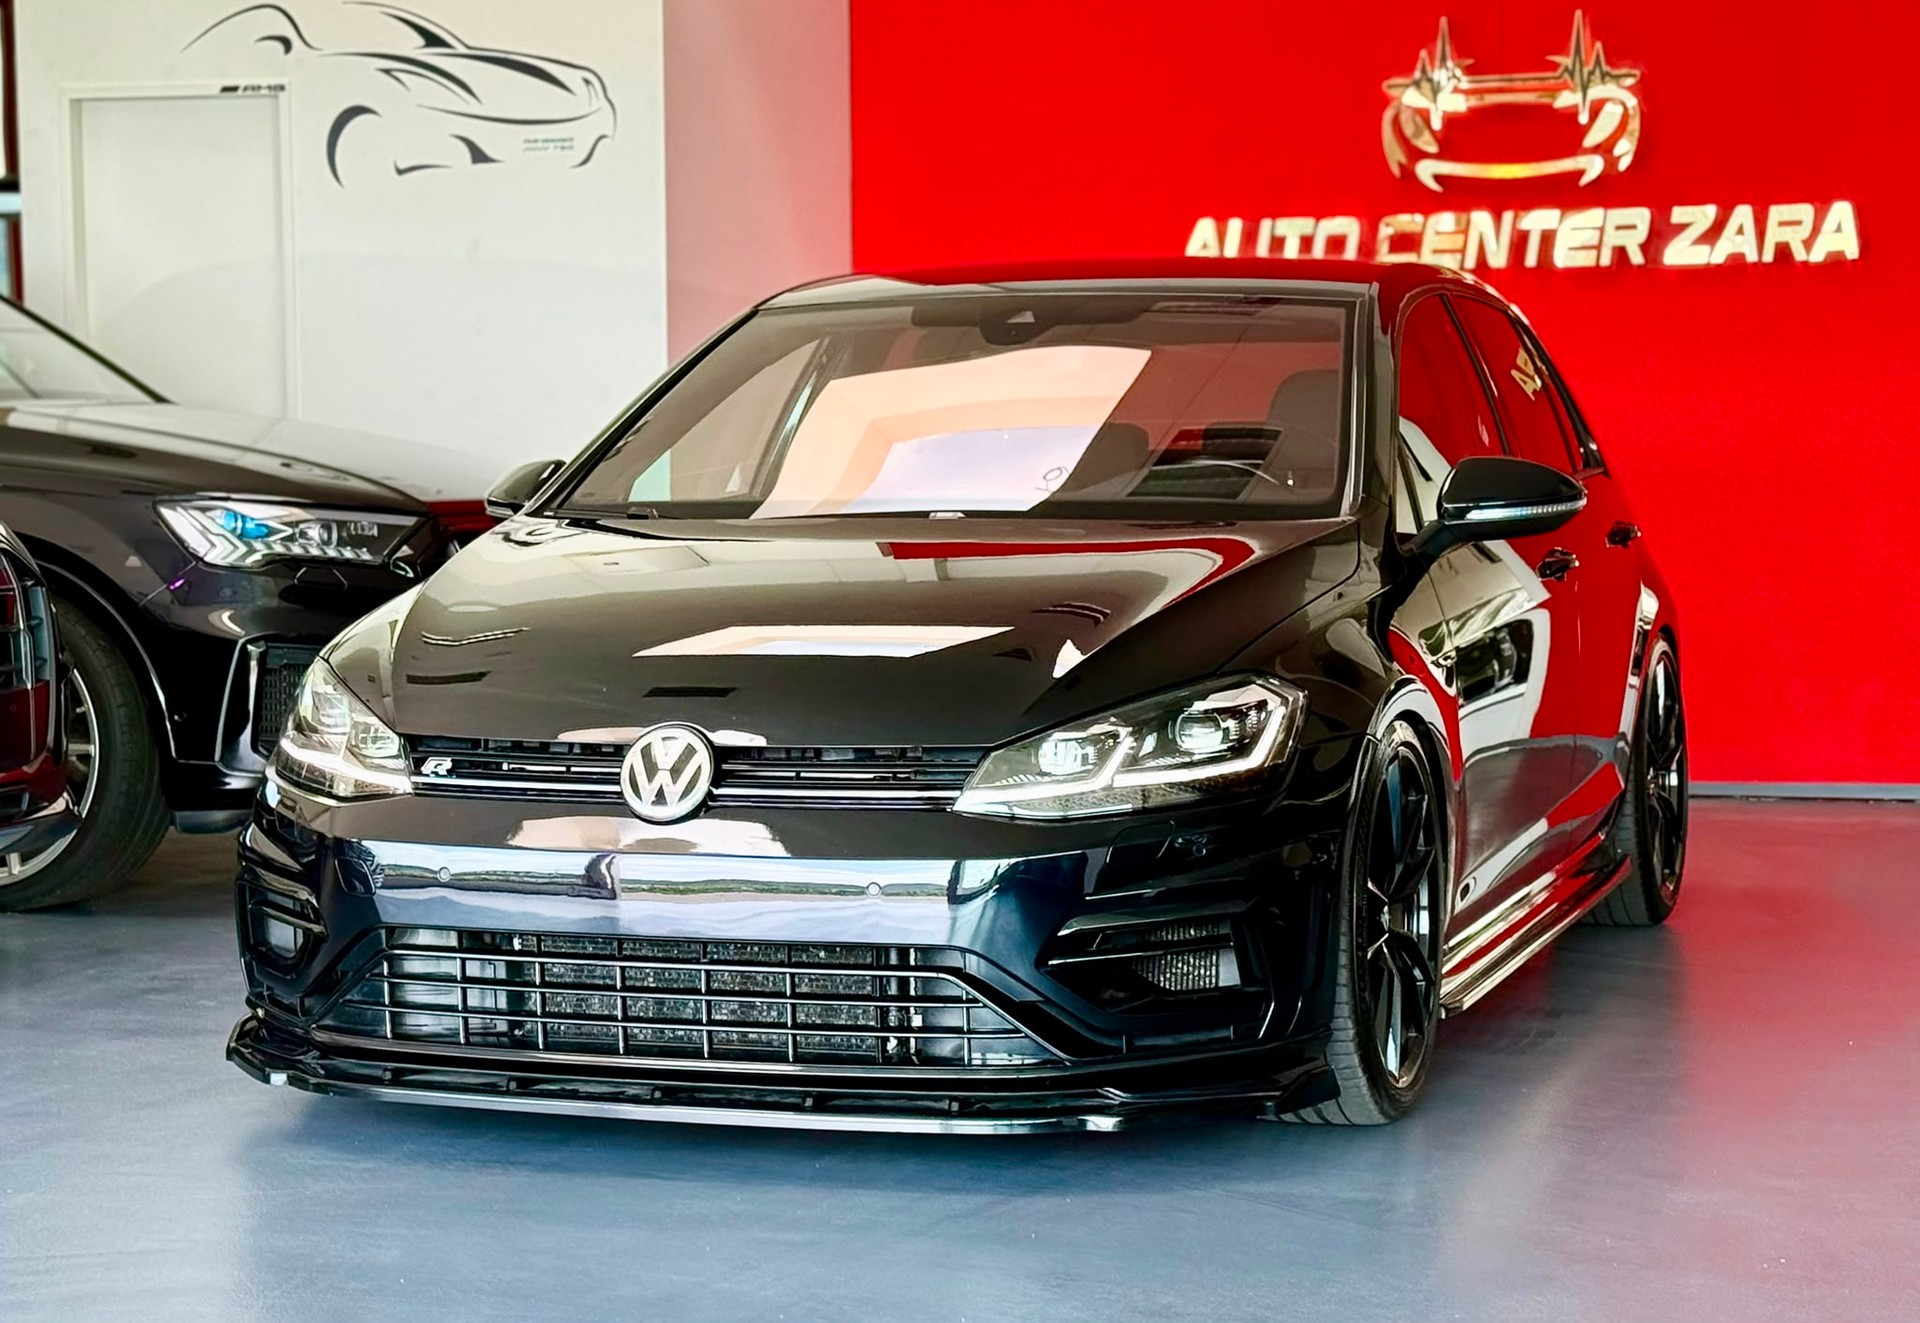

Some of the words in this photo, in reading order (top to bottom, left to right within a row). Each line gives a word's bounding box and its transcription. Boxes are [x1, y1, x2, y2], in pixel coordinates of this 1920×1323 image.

[1185, 215, 1361, 260] AUTO
[1374, 207, 1651, 270] CENTER
[1662, 200, 1860, 266] ZARA
[421, 757, 453, 777] R
